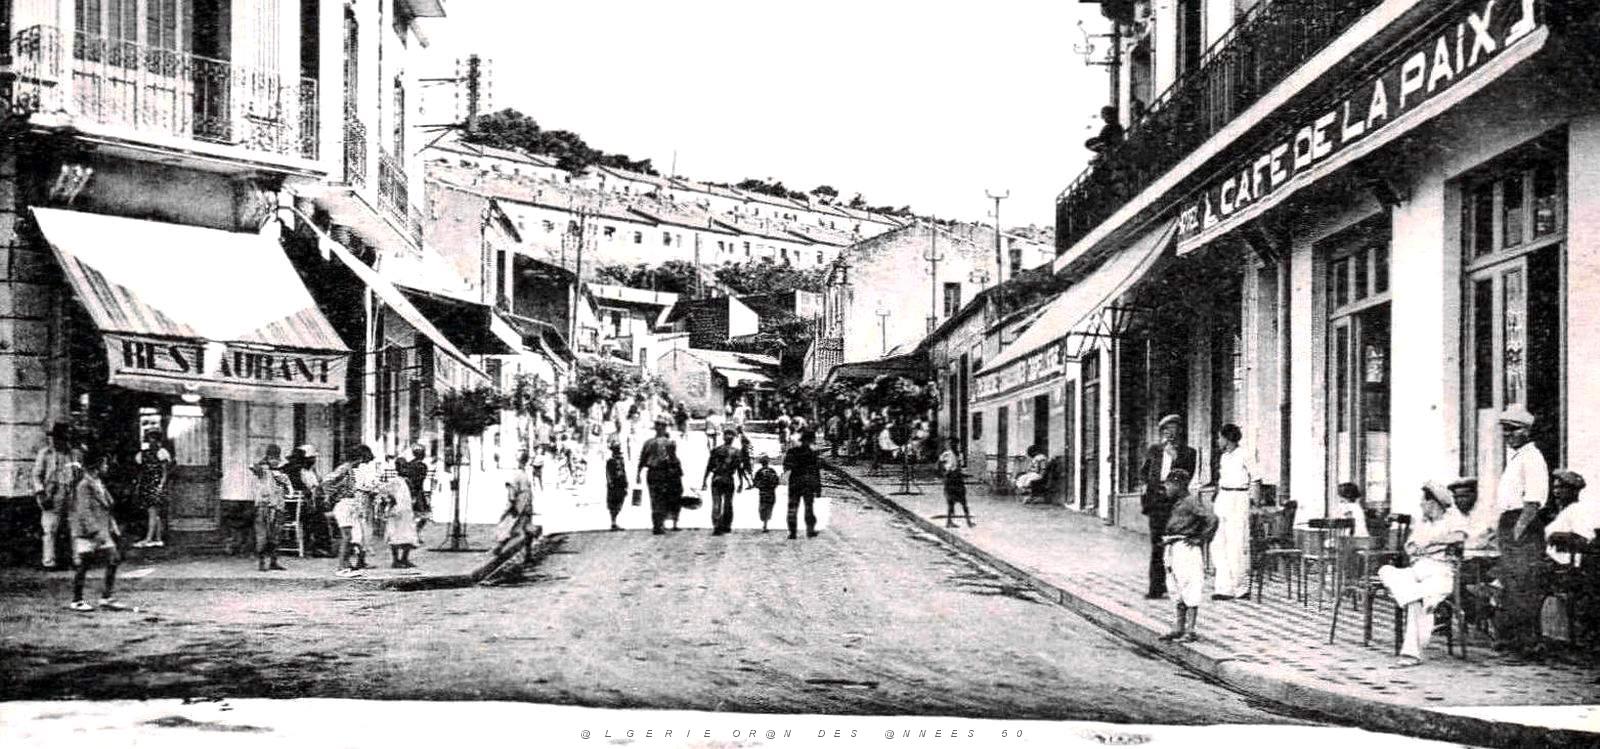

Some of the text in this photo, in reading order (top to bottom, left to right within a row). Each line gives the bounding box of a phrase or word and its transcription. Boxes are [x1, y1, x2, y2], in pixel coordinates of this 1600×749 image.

[1221, 0, 1496, 212] CAFE DE LA PAIX
